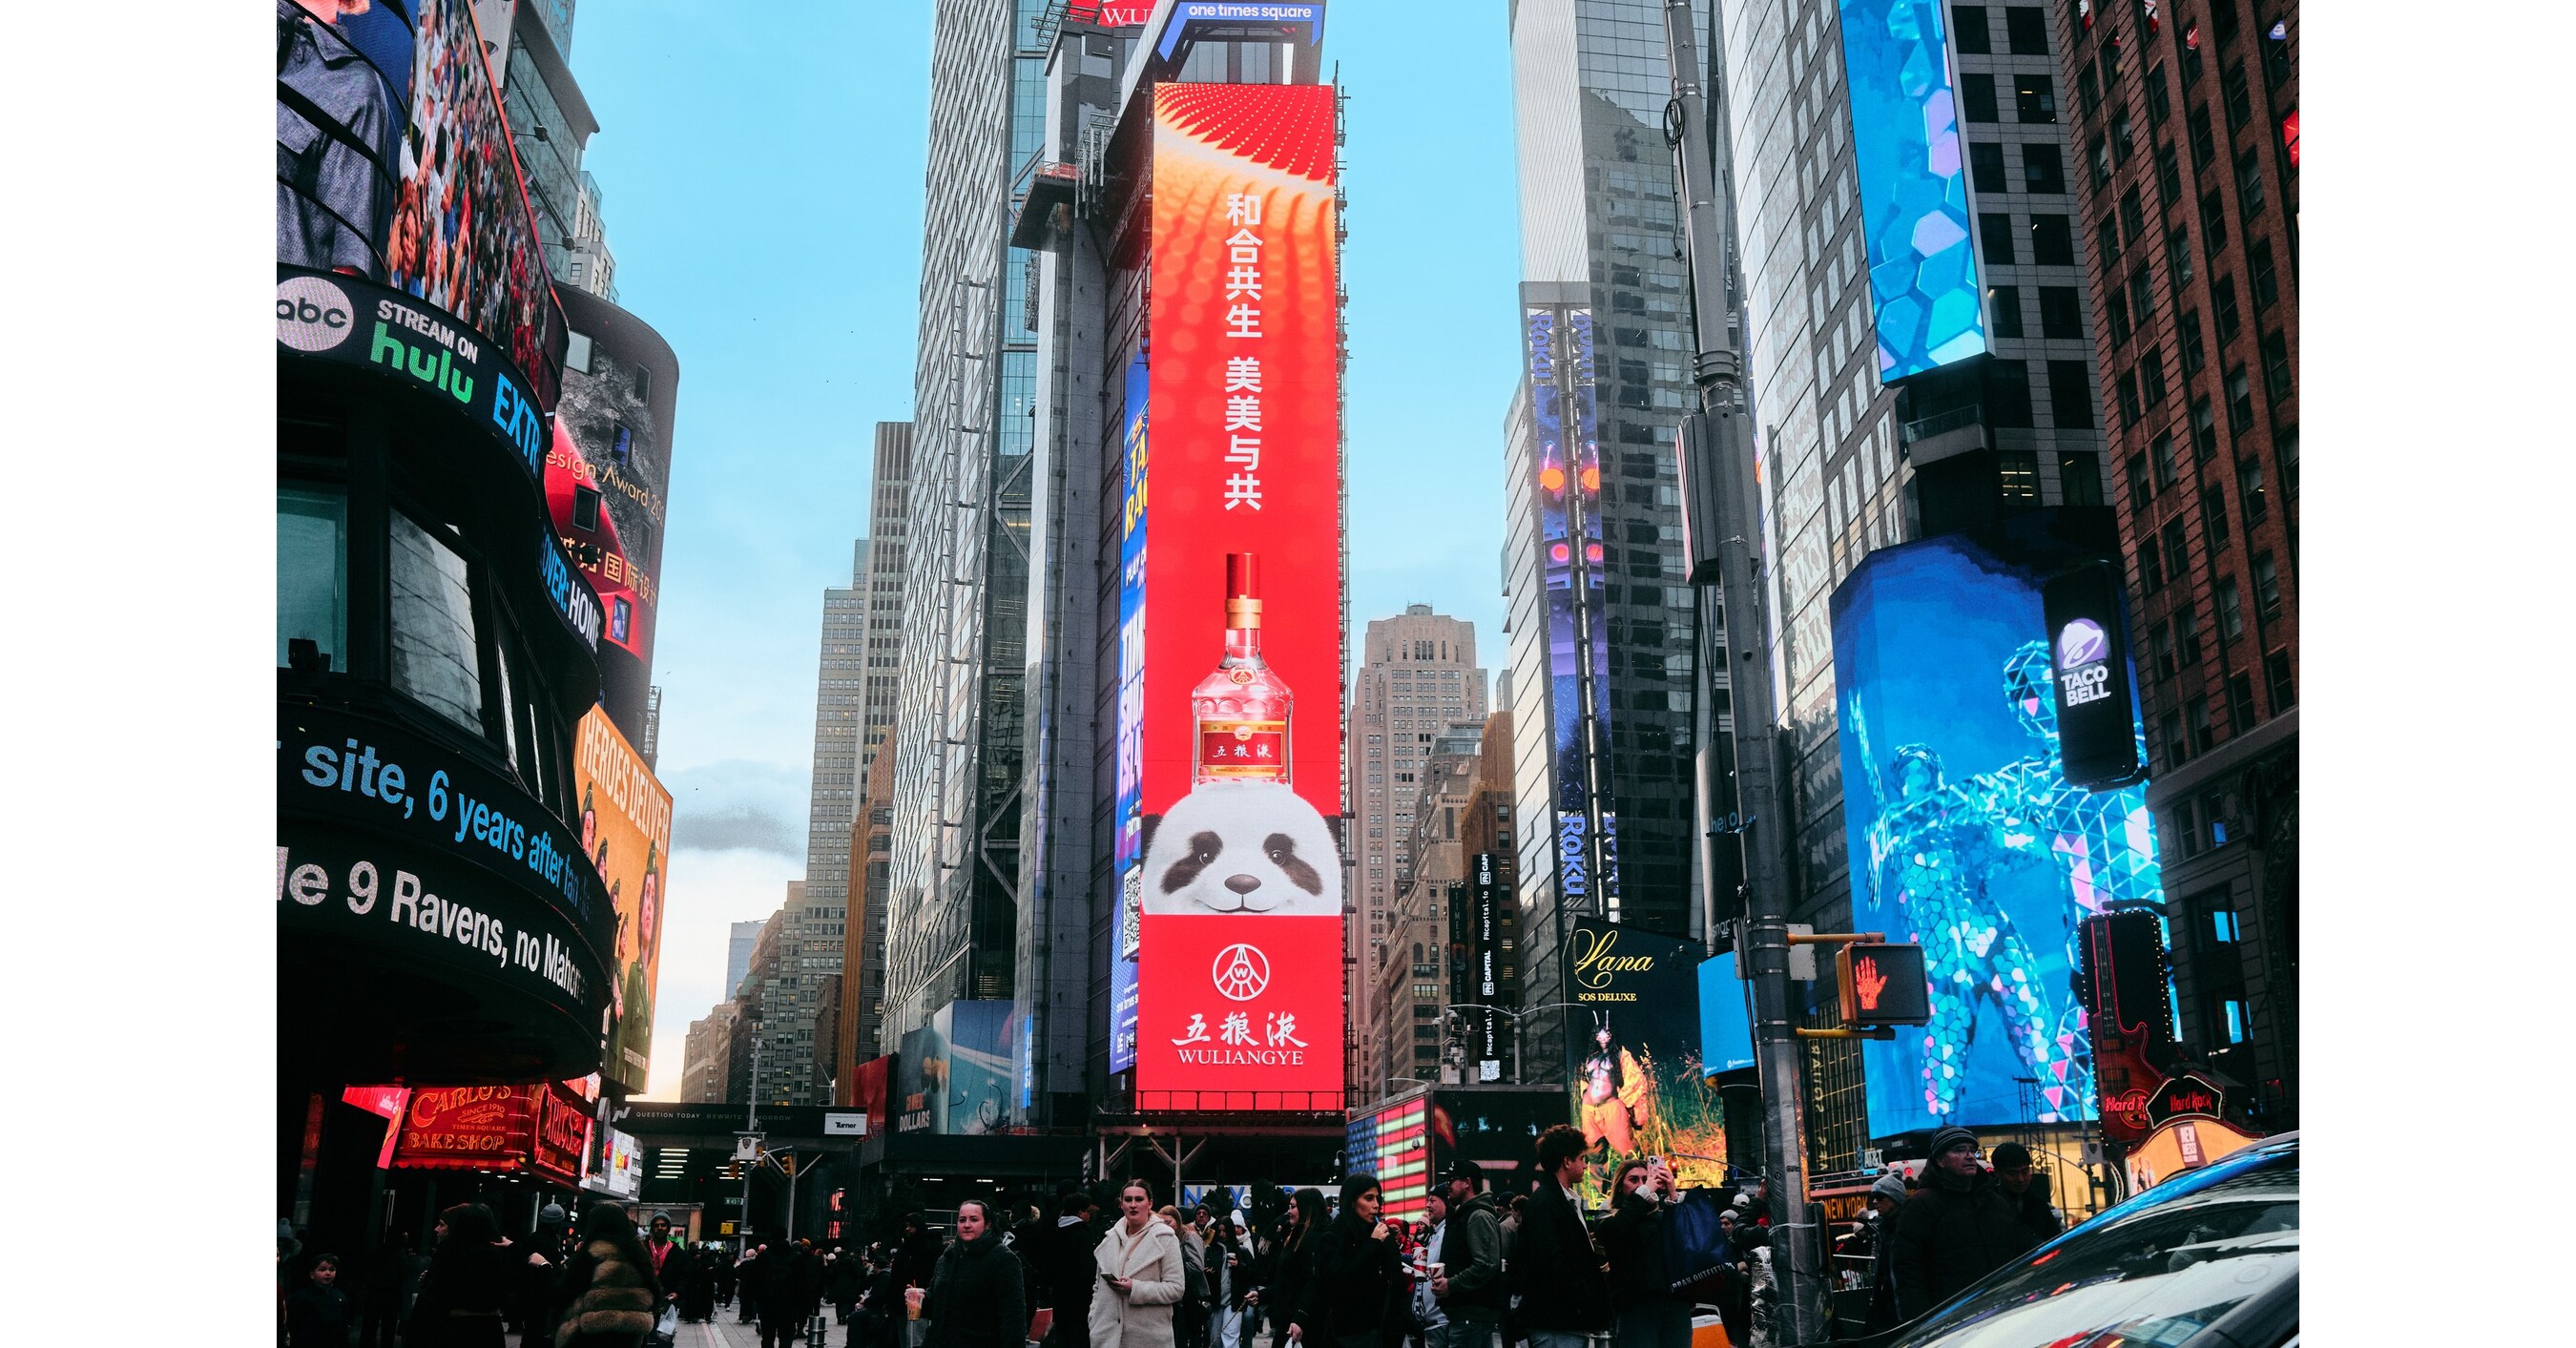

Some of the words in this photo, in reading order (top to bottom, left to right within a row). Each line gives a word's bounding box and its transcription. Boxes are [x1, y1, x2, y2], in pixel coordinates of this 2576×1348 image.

[1189, 6, 1215, 16] one
[1218, 5, 1259, 17] times
[1260, 5, 1312, 21] square
[1225, 193, 1263, 339] 和合共生
[277, 298, 347, 328] abc
[377, 300, 455, 349] STREAM
[457, 336, 478, 364] ON
[370, 321, 473, 404] hulu
[1527, 315, 1554, 380] ROKU
[1224, 356, 1263, 511] 美美与共
[545, 450, 596, 481] esign
[602, 466, 649, 508] Award
[541, 530, 570, 613] OVER:
[2060, 665, 2109, 690] TACO
[2066, 682, 2111, 707] BELL
[582, 712, 631, 813] HEROES
[628, 762, 672, 857] DELIVER
[301, 738, 414, 819] site,
[428, 770, 449, 821] 6
[454, 793, 525, 861] years
[528, 830, 564, 889] after
[1559, 817, 1587, 896] ROKU
[346, 861, 379, 915] 9
[390, 869, 509, 968] Ravens,
[514, 929, 540, 972] no
[544, 933, 588, 1005] Mahom
[1578, 993, 1596, 1002] SOS
[1597, 992, 1637, 1002] DELUXE
[1171, 1011, 1309, 1047] 五粮液
[1176, 1049, 1304, 1067] WULIANGYE
[462, 1105, 488, 1118] SINCE
[488, 1103, 506, 1113] 1910
[2105, 1095, 2135, 1112] Hard
[2169, 1093, 2191, 1112] Hard
[2192, 1090, 2212, 1113] Rock
[899, 1110, 930, 1133] DOLLARS
[408, 1132, 455, 1150] BAKE
[456, 1134, 505, 1151] SHOP
[1864, 1150, 1883, 1168] AT&T
[1824, 1198, 1843, 1220] NEW
[1845, 1196, 1868, 1218] YORK
